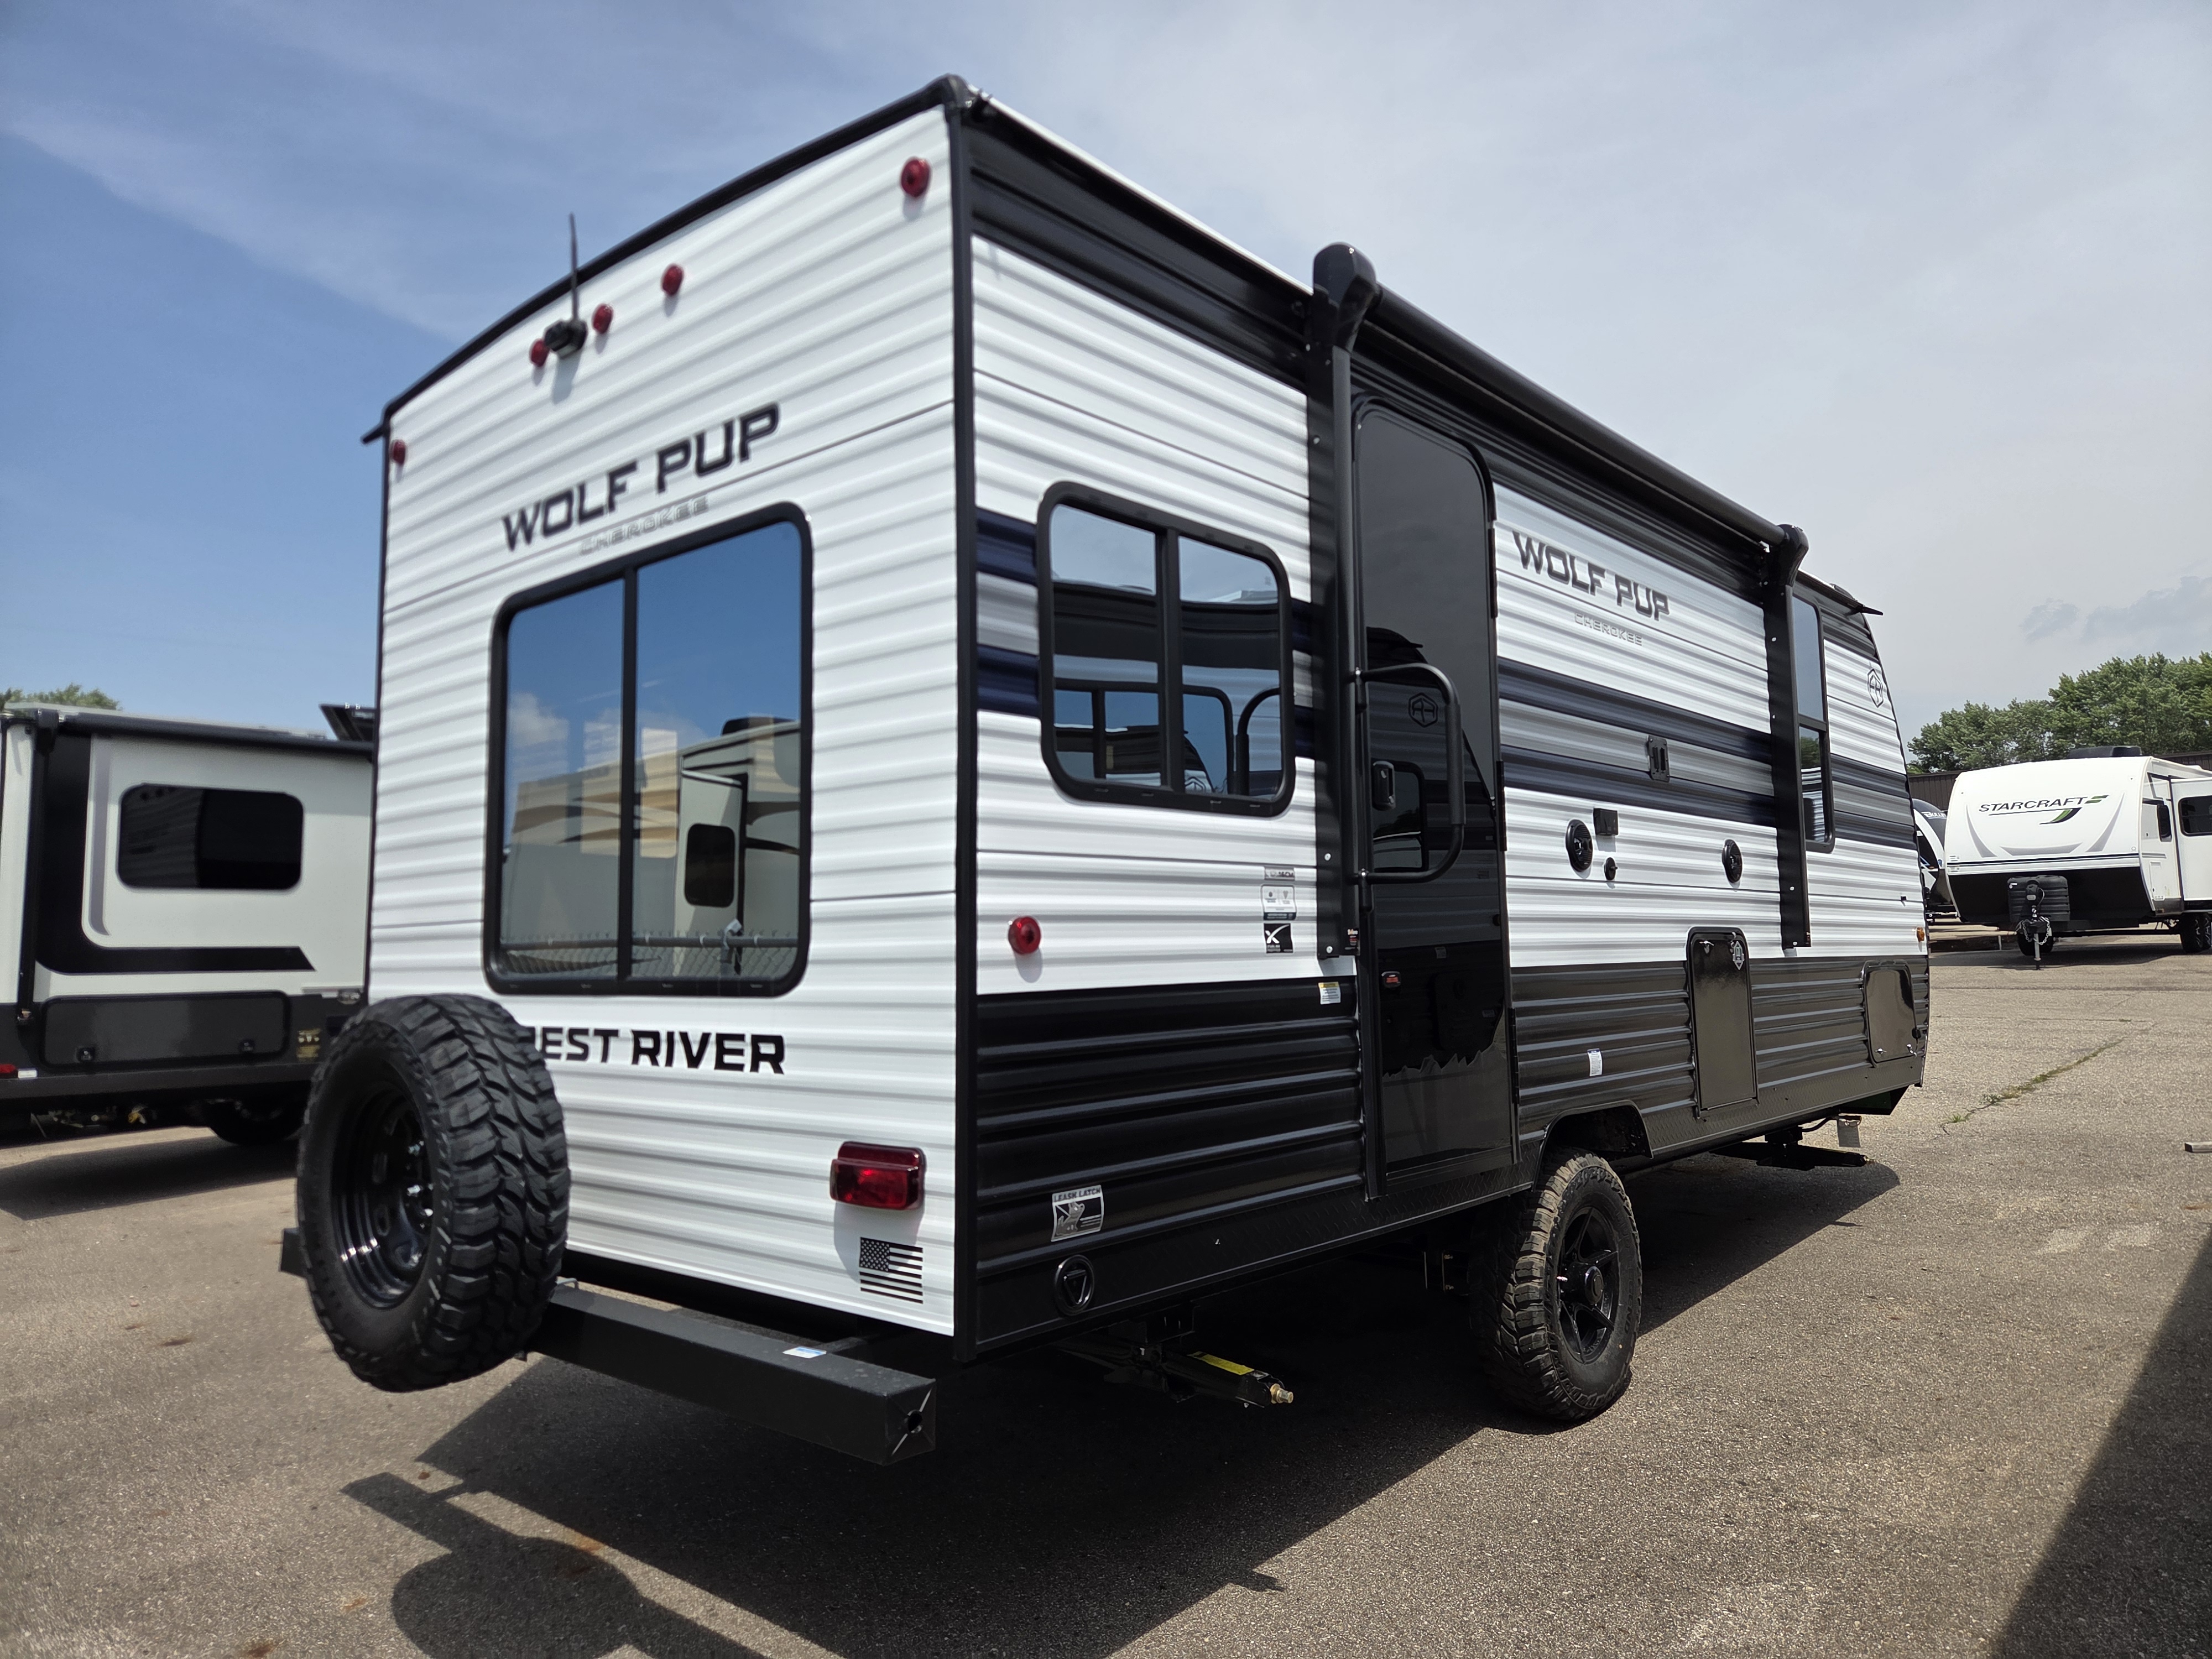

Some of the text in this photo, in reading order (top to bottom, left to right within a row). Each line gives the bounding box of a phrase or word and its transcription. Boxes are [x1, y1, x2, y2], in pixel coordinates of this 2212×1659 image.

[502, 402, 779, 552] WOLF PUP
[580, 497, 709, 555] CHEROKEE
[1512, 530, 1670, 622] WOLF PUP
[1574, 612, 1643, 646] CHEROKEE
[1979, 796, 2088, 812] STARCRAFT
[524, 1026, 785, 1075] EST RIVER
[1054, 1187, 1101, 1202] LEASH LATCH
